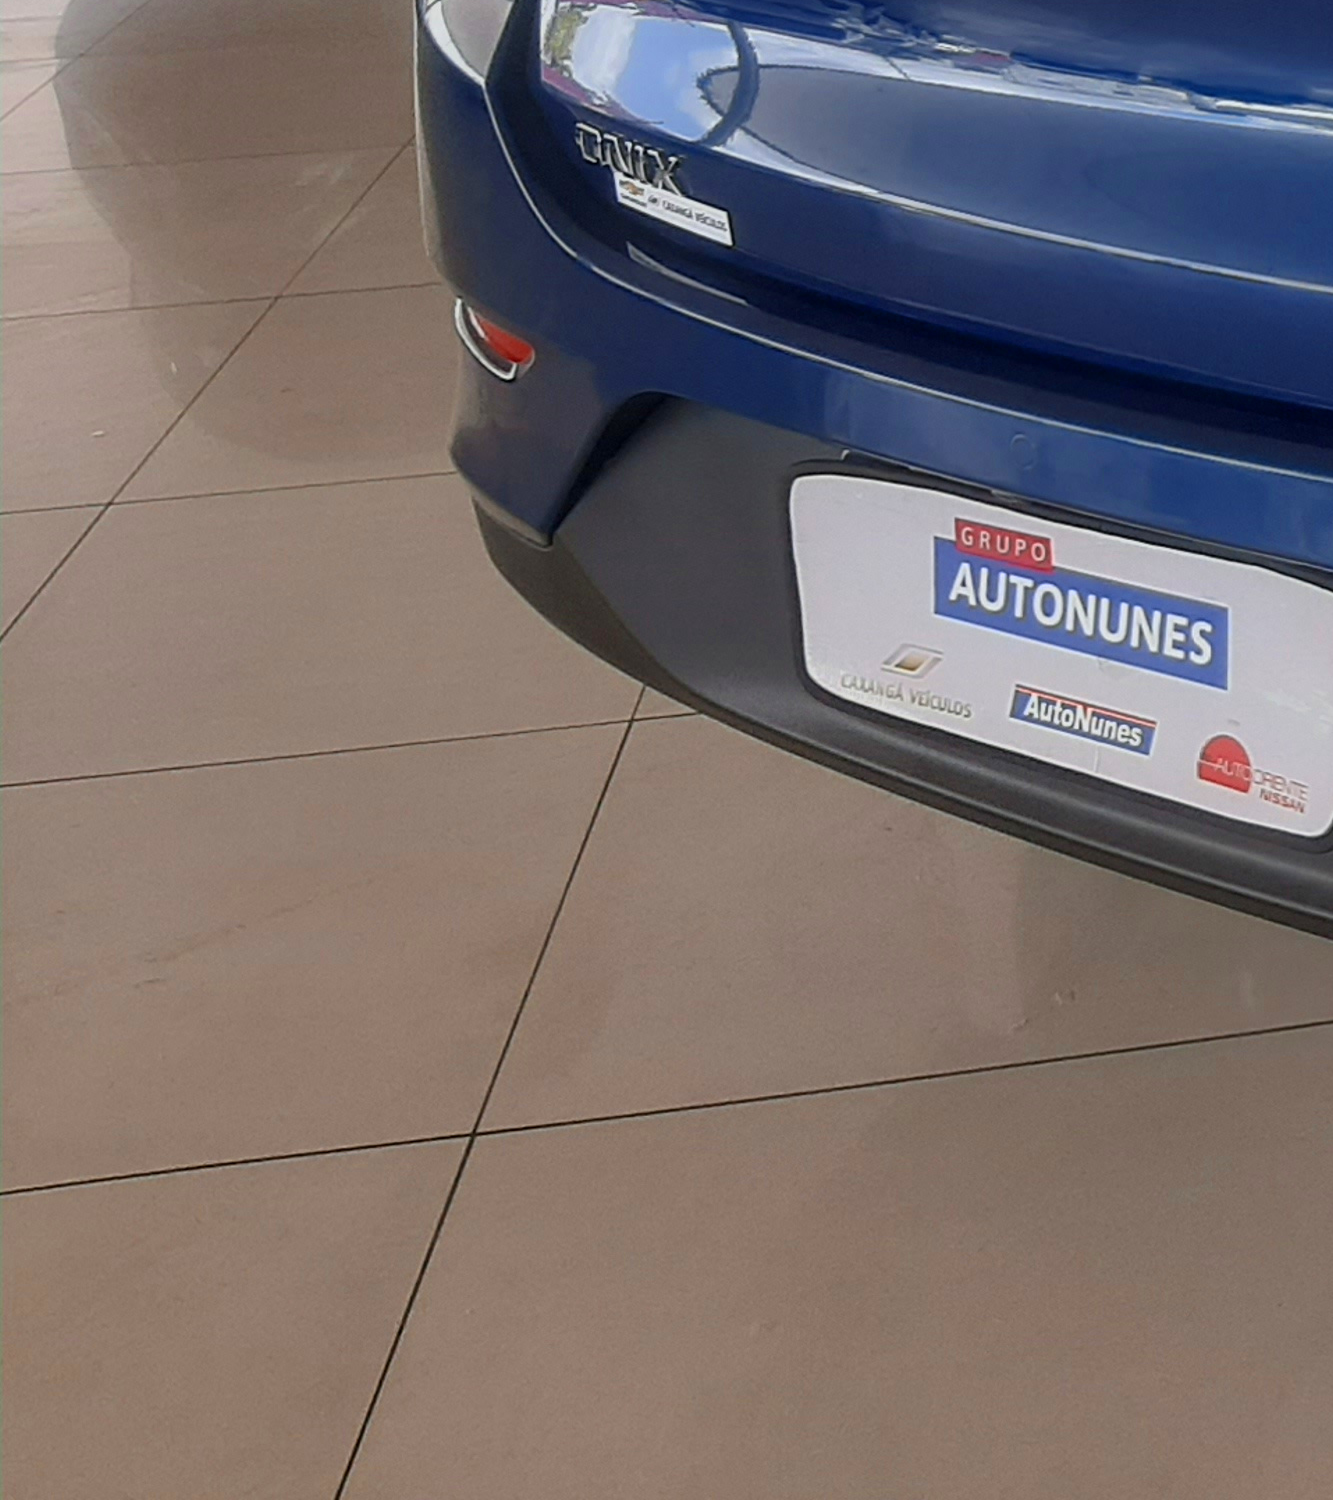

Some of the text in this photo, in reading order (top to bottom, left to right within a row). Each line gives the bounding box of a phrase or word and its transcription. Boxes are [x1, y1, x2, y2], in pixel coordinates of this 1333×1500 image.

[575, 120, 685, 197] ONIX
[960, 526, 1046, 563] GRUPO
[949, 562, 1213, 665] AUTONUNES
[909, 687, 972, 719] VEÍCULOS
[1023, 693, 1143, 747] AutoNunes
